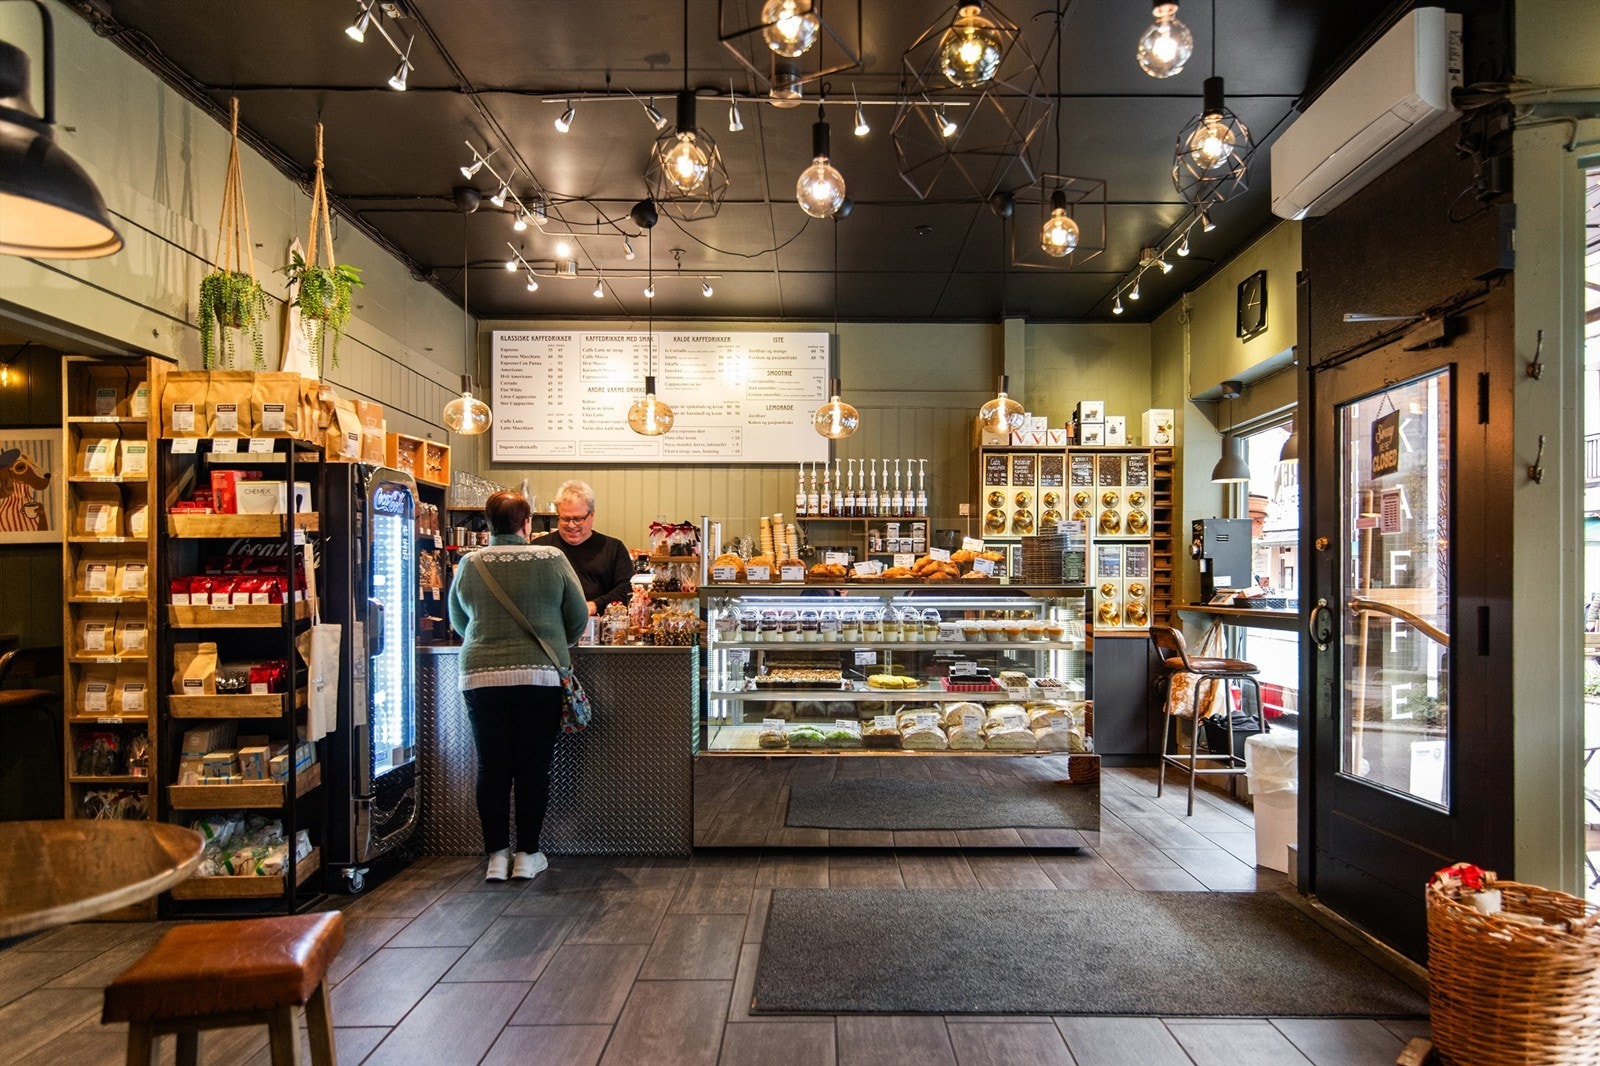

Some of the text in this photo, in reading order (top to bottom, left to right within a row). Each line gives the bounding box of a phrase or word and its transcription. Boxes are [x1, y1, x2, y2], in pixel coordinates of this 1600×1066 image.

[1376, 424, 1394, 444] Sorry
[1373, 449, 1397, 472] CLOSED
[374, 488, 405, 514] Coca-Cola
